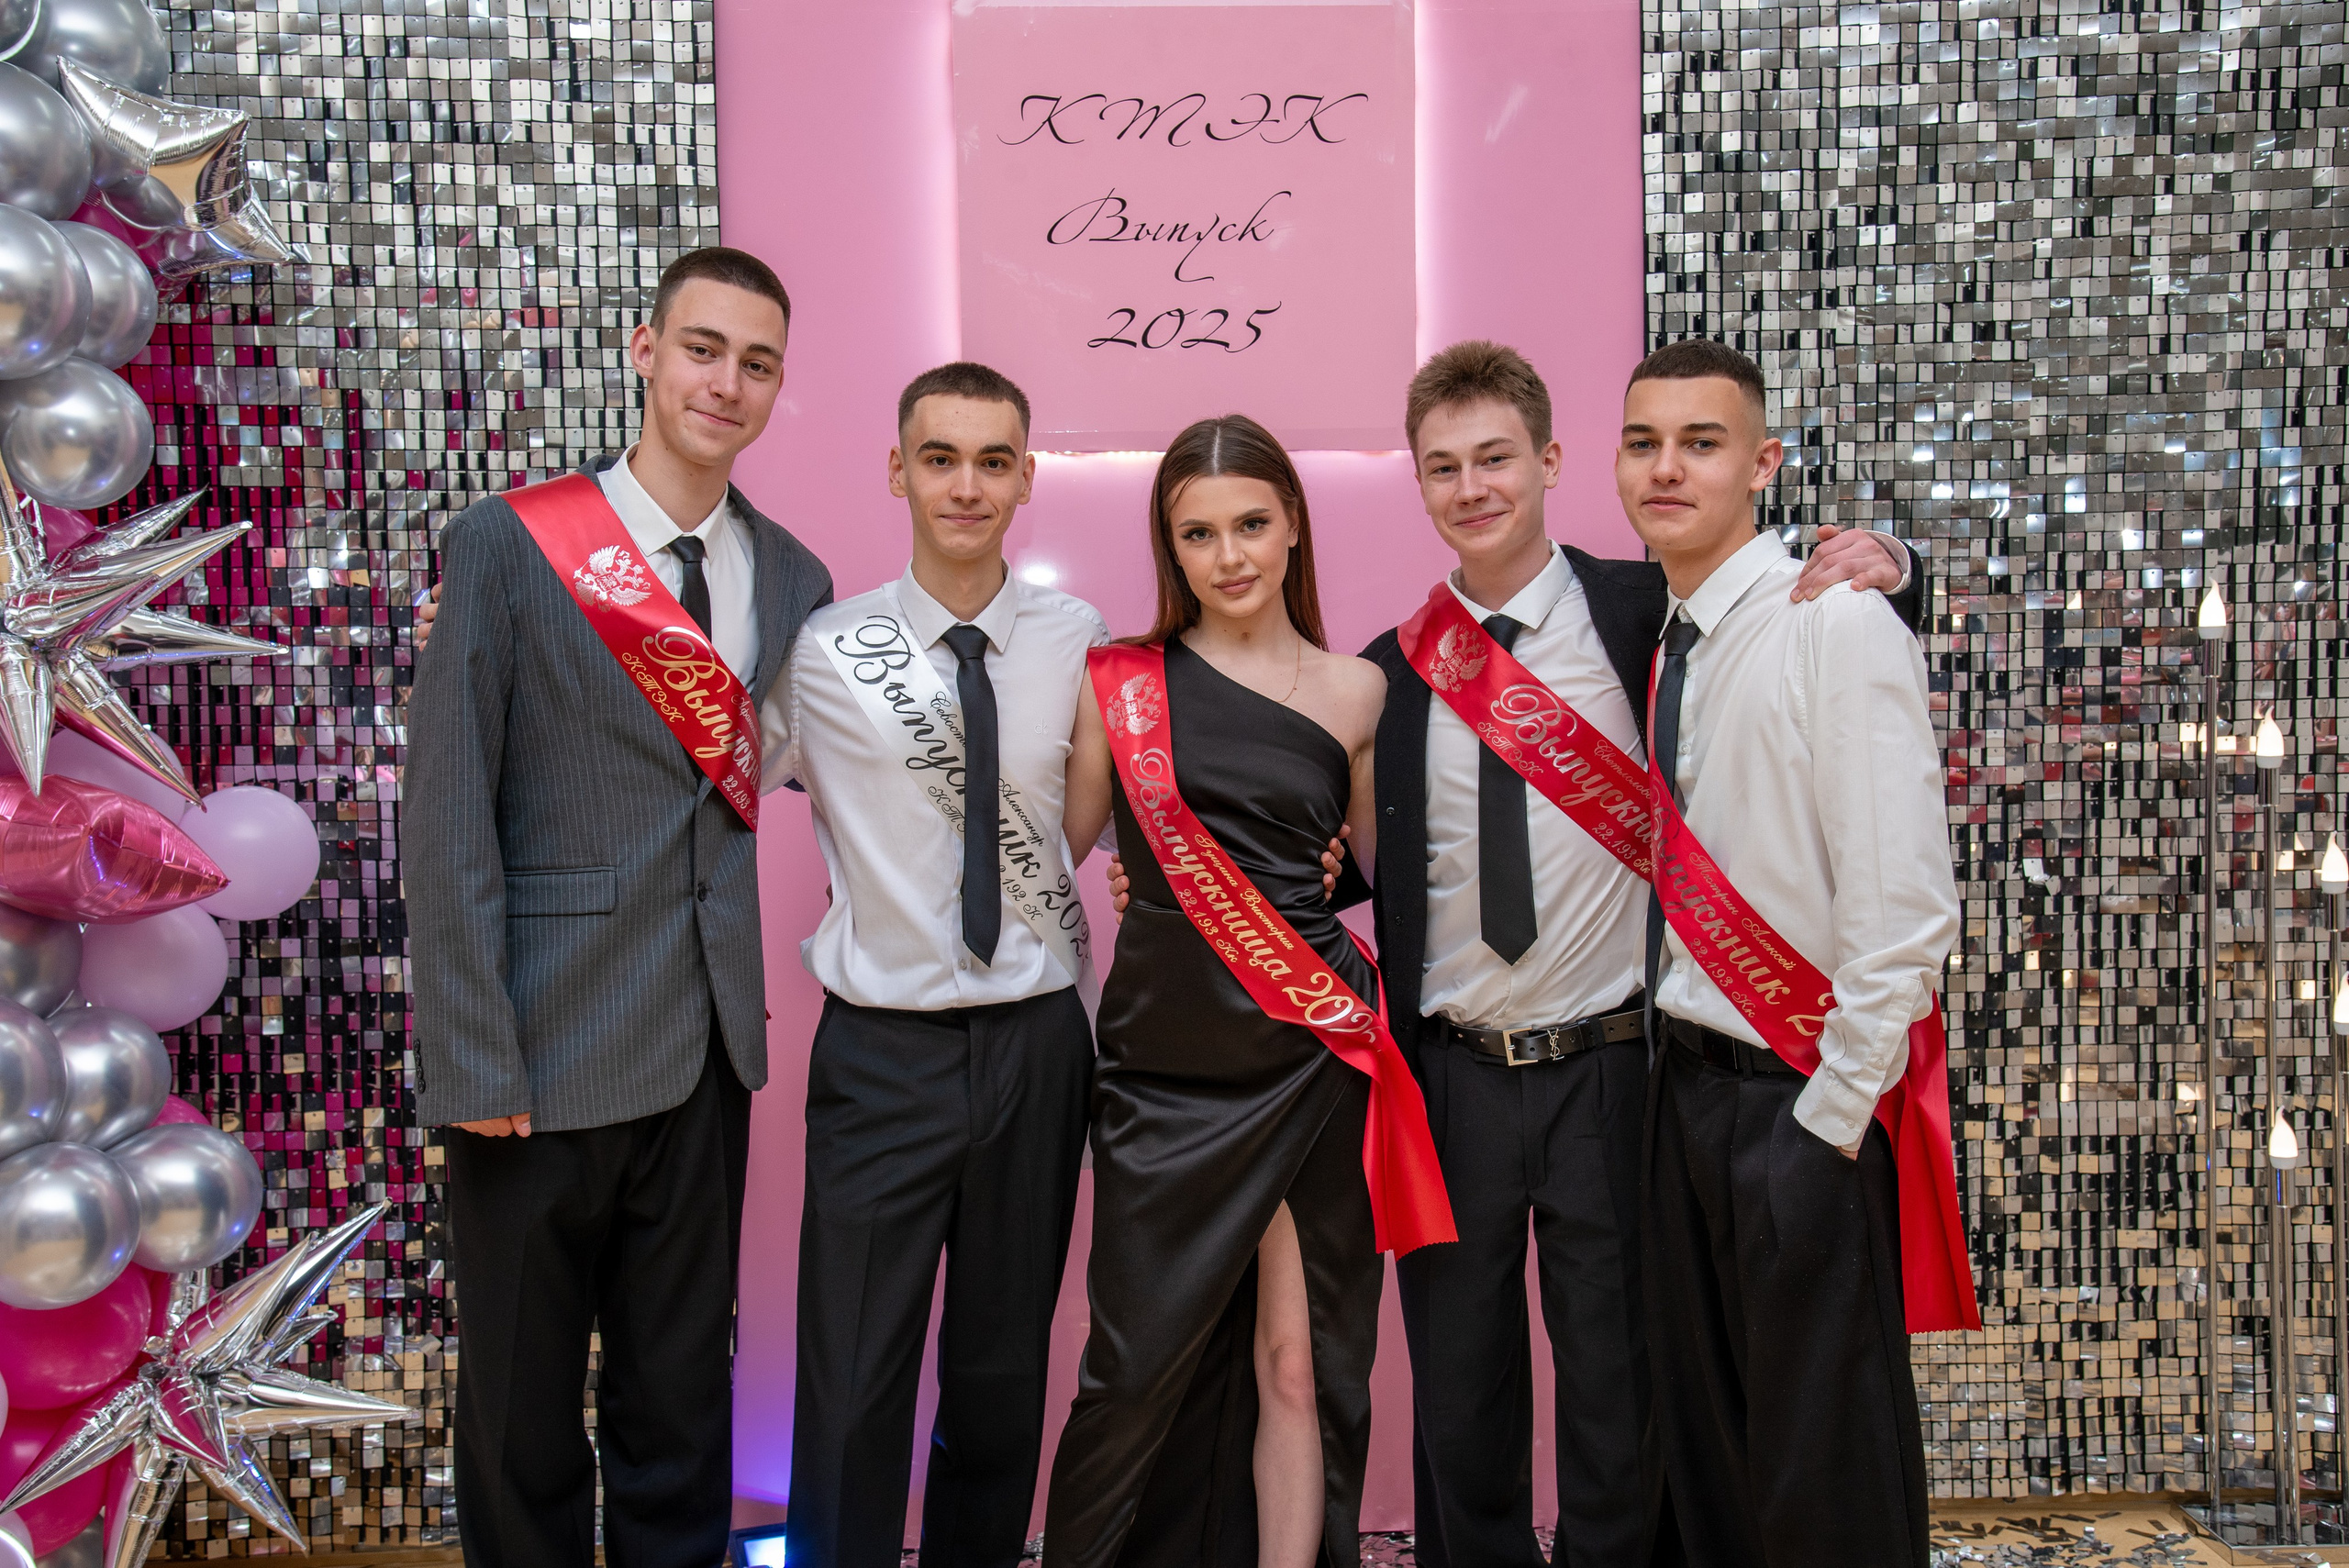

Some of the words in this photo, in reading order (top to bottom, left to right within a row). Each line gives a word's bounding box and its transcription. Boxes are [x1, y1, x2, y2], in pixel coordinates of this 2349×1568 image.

[996, 93, 1369, 147] КТЭК
[1046, 187, 1292, 283] Выпуск
[1086, 301, 1282, 353] 2025
[621, 652, 685, 723] КТЭК
[721, 774, 751, 809] 22.193
[1477, 721, 1543, 778] КТЭК
[1591, 822, 1637, 860] 22.193
[1124, 777, 1161, 850] КТЭК
[1178, 888, 1219, 936] 22.193
[1130, 747, 1293, 981] Выпускница
[1022, 904, 1043, 921] К
[1036, 873, 1090, 961] 202
[1240, 887, 1295, 951] Виктория
[1741, 917, 1797, 972] Алексей
[1689, 937, 1734, 988] 22.193
